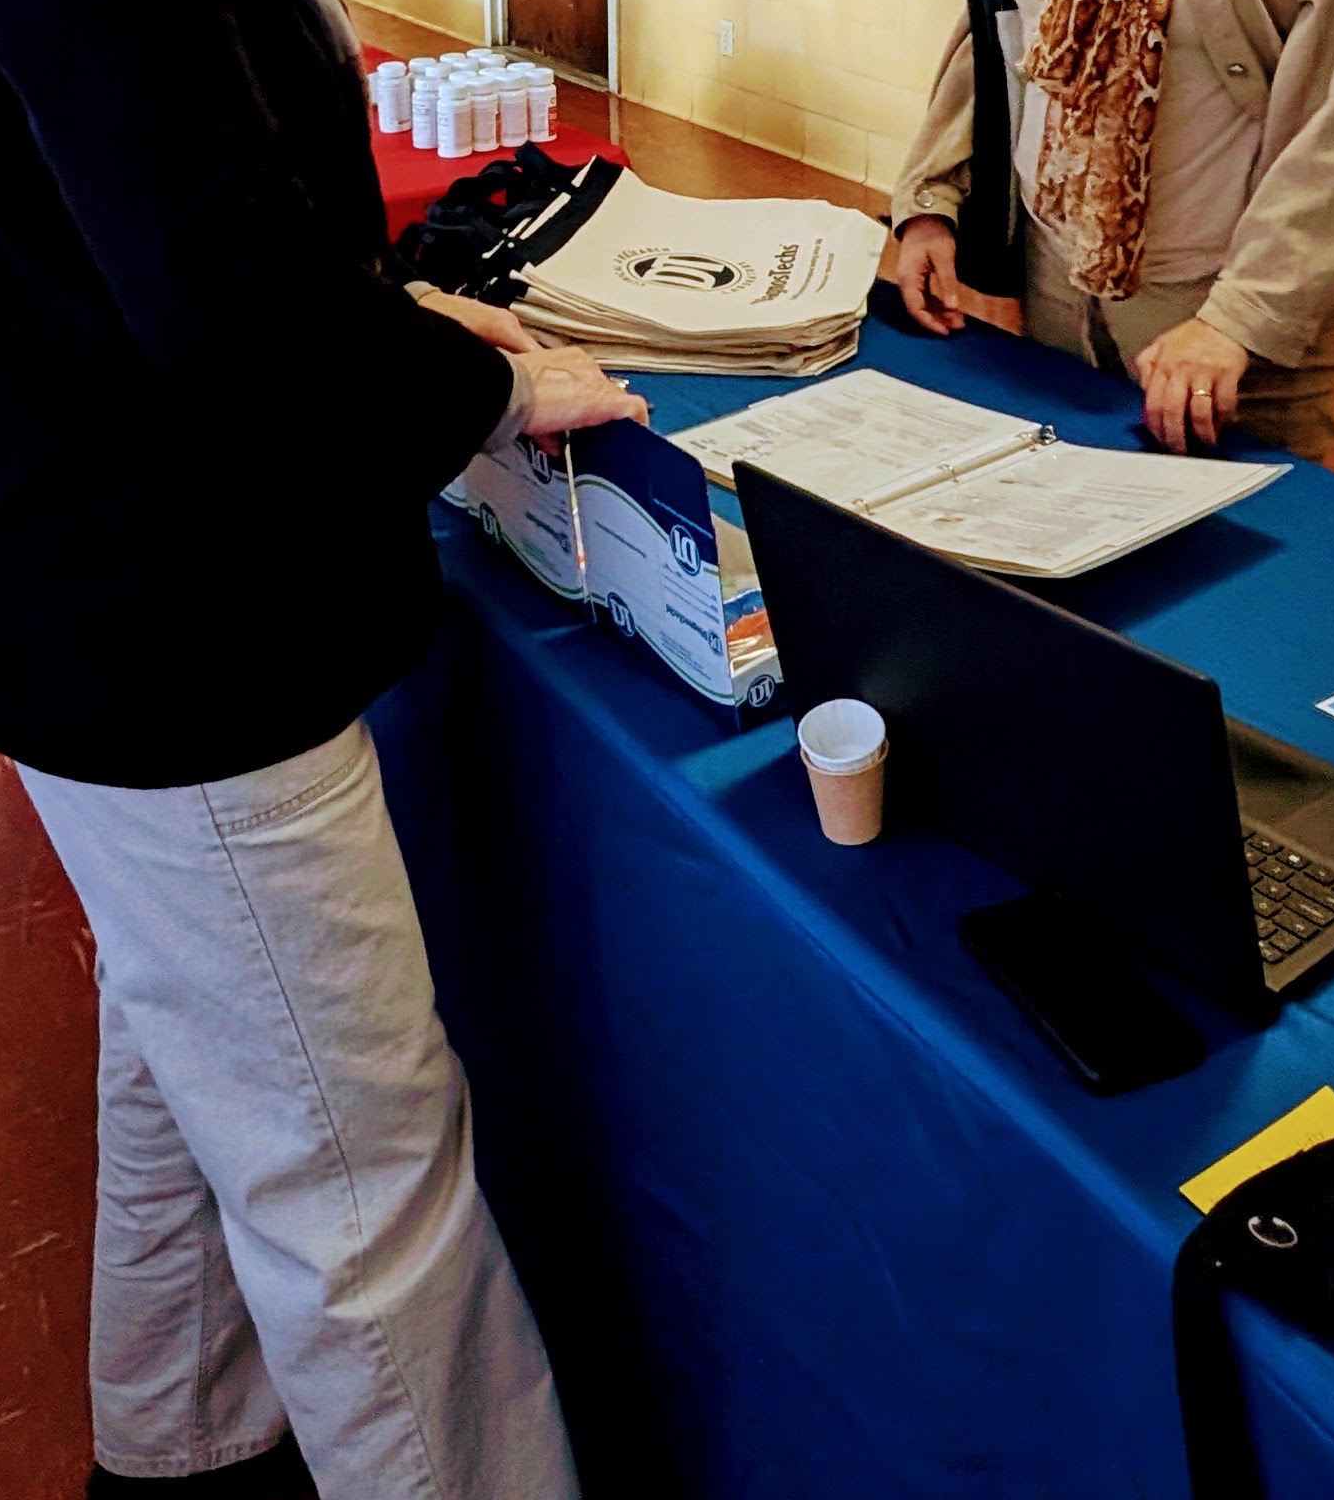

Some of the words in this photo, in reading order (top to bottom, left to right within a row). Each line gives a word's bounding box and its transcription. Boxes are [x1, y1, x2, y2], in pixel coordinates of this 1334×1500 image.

[649, 256, 725, 292] DT
[674, 530, 698, 573] DT
[612, 598, 634, 633] DT
[750, 679, 773, 705] DT
